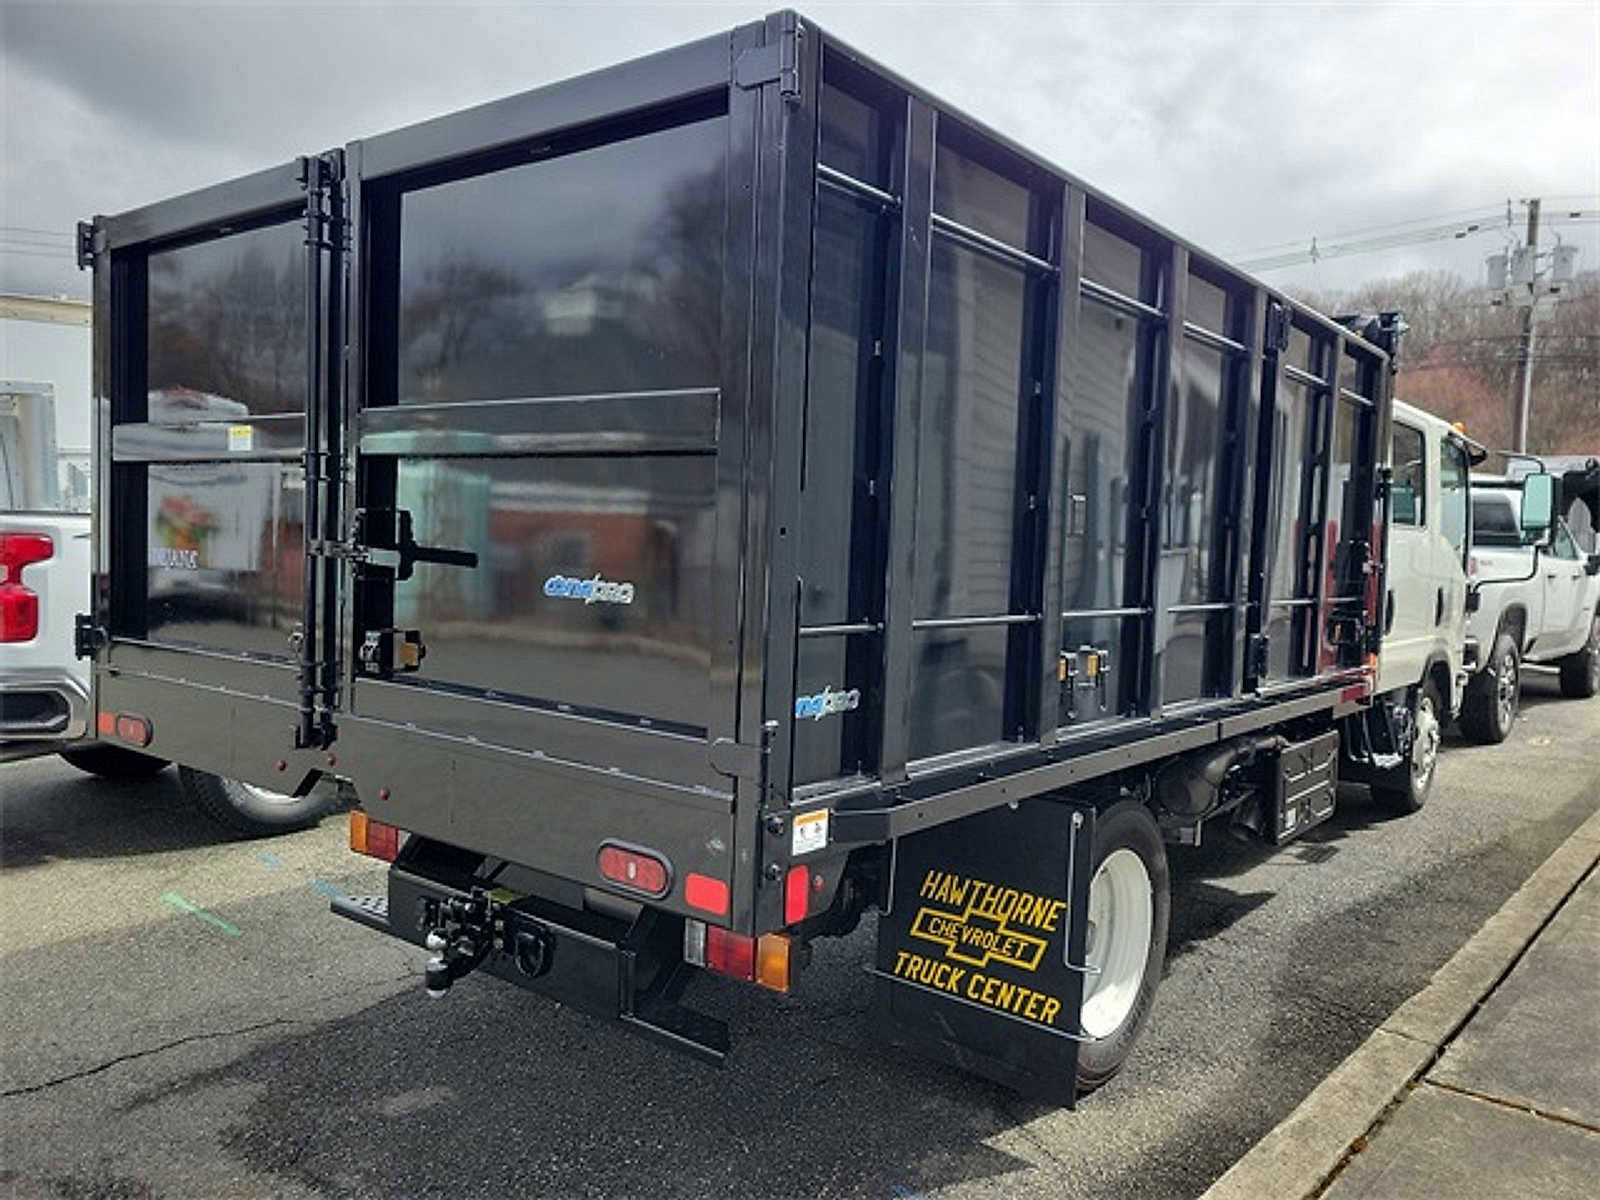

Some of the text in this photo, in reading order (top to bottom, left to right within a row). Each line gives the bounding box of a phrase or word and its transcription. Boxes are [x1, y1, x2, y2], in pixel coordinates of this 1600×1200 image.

[920, 870, 1067, 932] HAWTHORNE
[927, 917, 1029, 959] CHEVROLET
[894, 952, 1062, 1024] TRUCK CENTER
